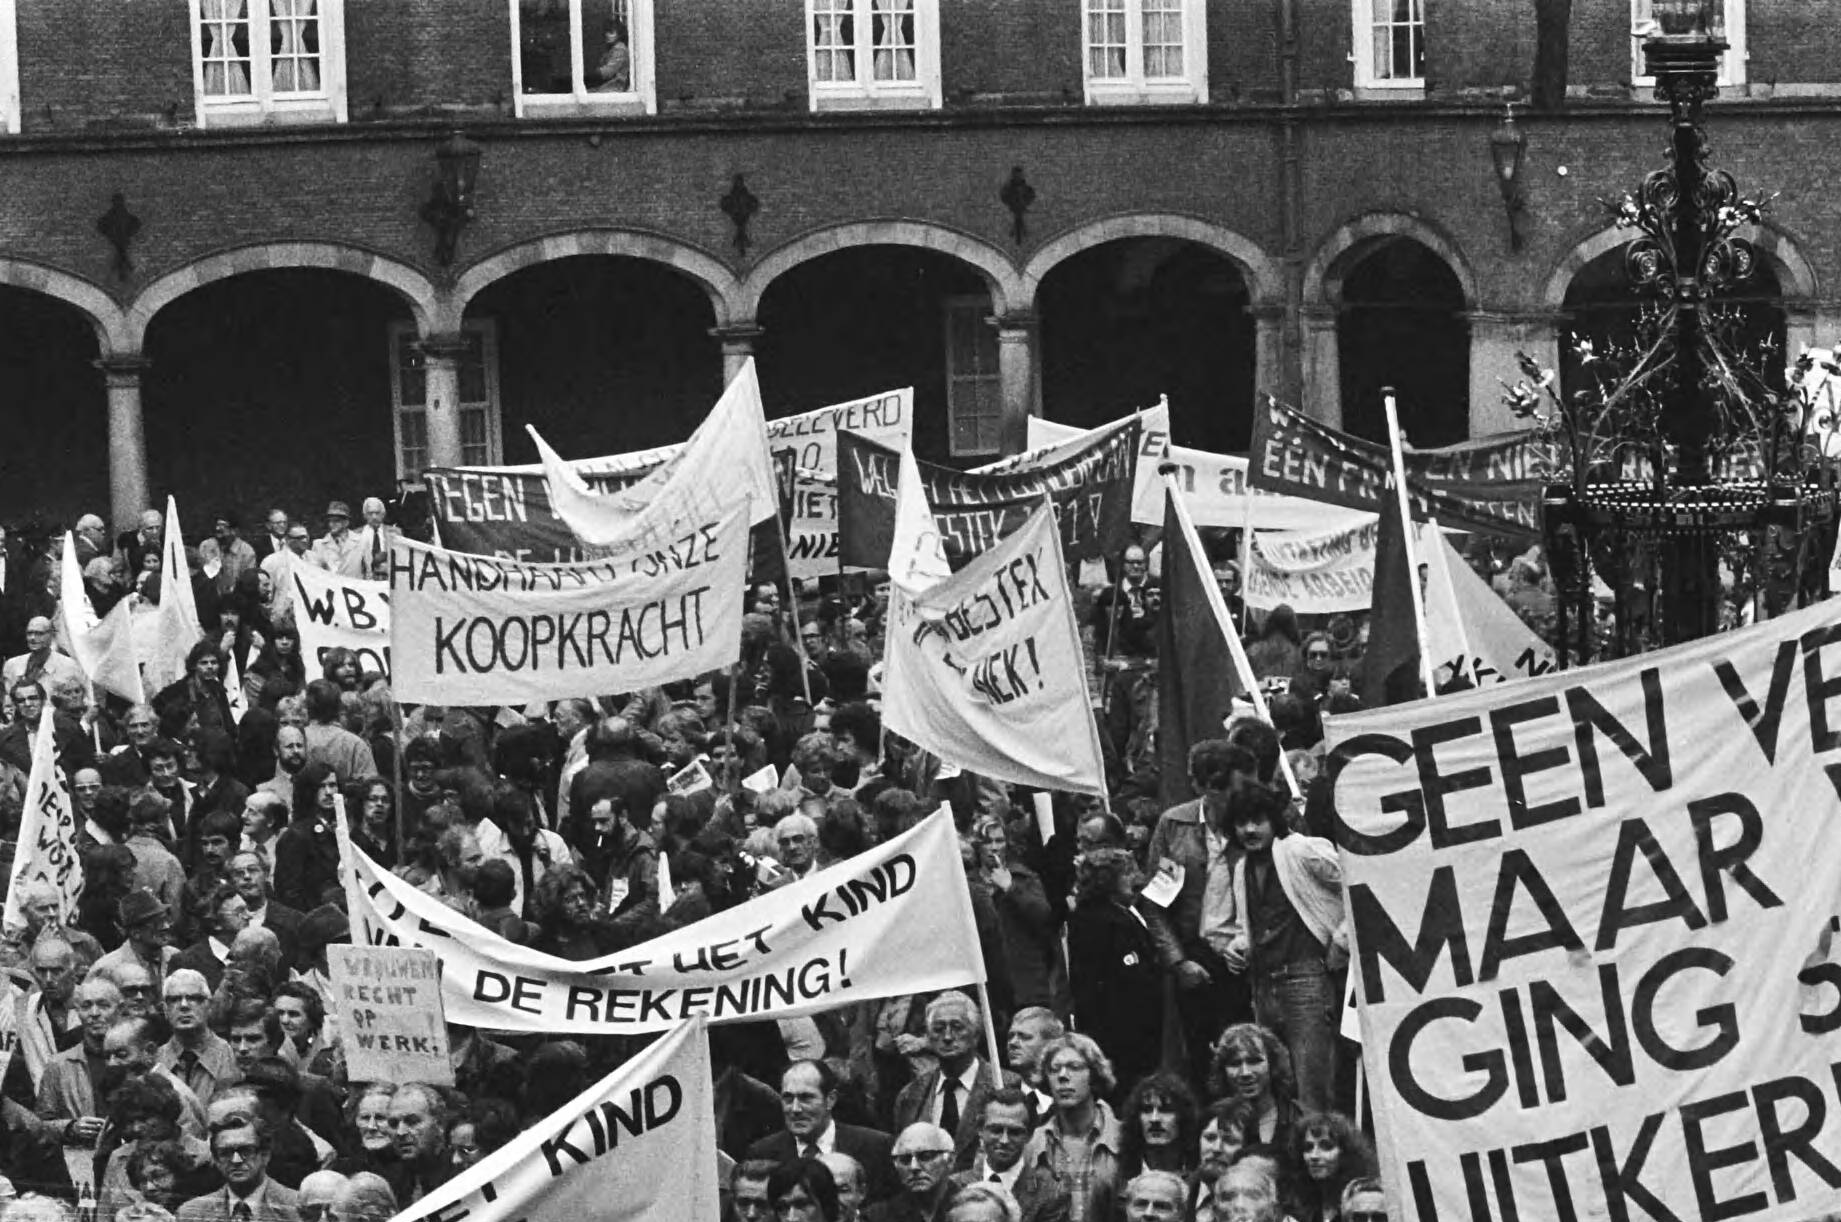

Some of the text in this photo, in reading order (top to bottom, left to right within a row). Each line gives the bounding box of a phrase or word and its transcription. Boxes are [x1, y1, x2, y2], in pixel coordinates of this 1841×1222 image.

[423, 472, 528, 523] TEGEN
[434, 585, 711, 675] KOOPKRACHT
[1333, 667, 1673, 856] GEEN
[802, 852, 917, 933] KIND
[1350, 793, 1784, 1004] MAAR
[343, 983, 417, 1006] RECHT
[353, 1007, 377, 1029] OP
[473, 947, 853, 1023] DE REKENING!
[1387, 948, 1738, 1121] GING
[540, 1074, 683, 1177] KIND
